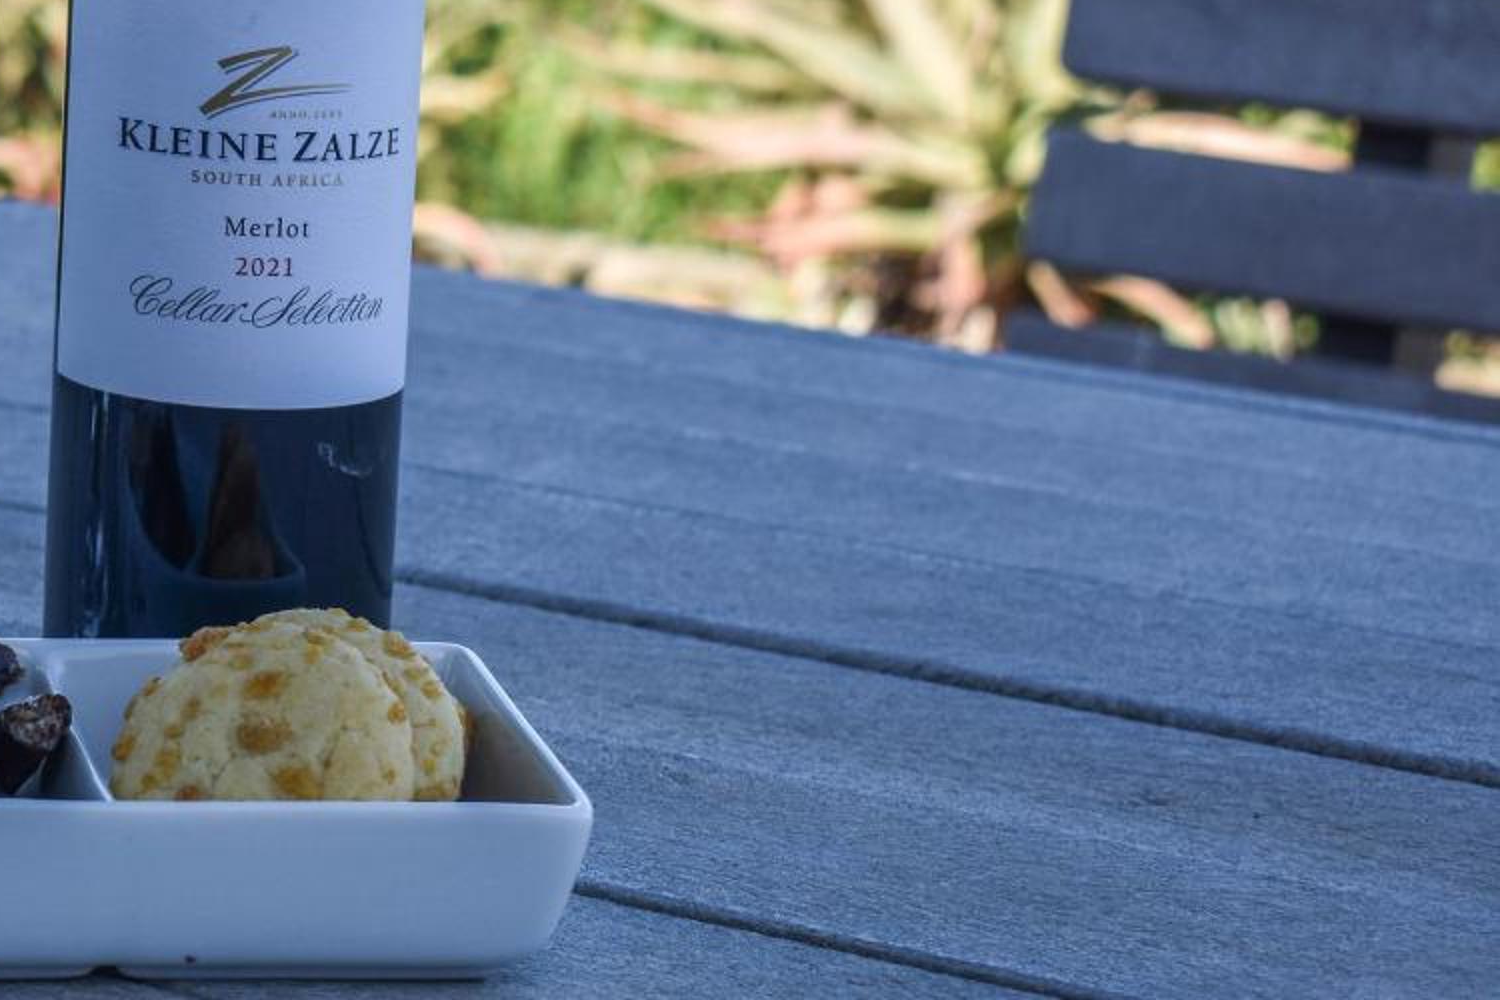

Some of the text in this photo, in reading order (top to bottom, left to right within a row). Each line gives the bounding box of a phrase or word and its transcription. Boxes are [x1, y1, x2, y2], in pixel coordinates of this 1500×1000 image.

[118, 116, 400, 163] KLEINE ZALZE
[191, 169, 345, 188] SOUTH AFRICA
[224, 216, 310, 239] Merlot
[234, 257, 293, 277] 2021
[129, 274, 383, 329] Cellar Selection
